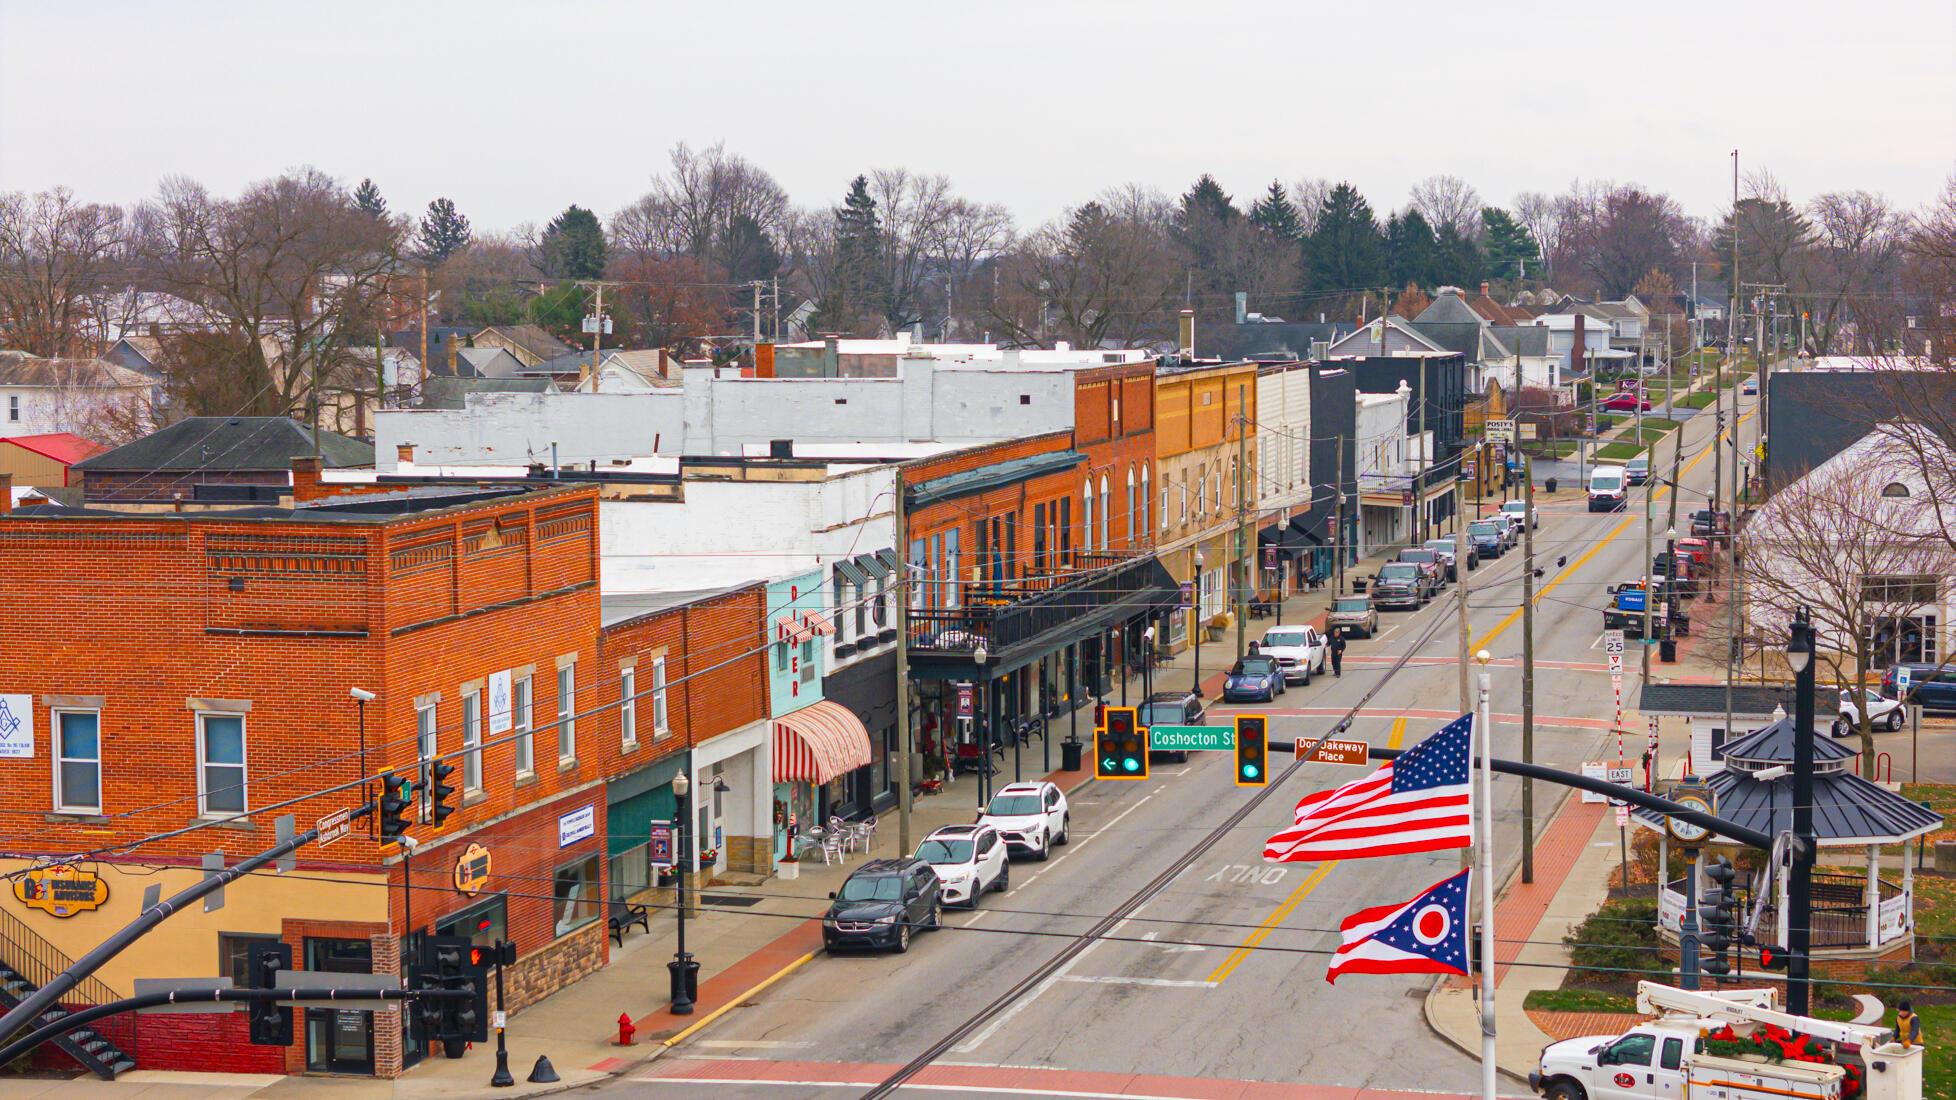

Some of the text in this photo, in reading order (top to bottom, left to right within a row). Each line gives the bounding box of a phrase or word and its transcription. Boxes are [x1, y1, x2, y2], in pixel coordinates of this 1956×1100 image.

[1607, 642, 1623, 652] 25
[1154, 731, 1218, 745] Coshocton
[1320, 740, 1364, 754] Jakeway
[1318, 750, 1345, 762] Place
[1612, 770, 1629, 779] EAST
[1204, 864, 1288, 885] ONLY
